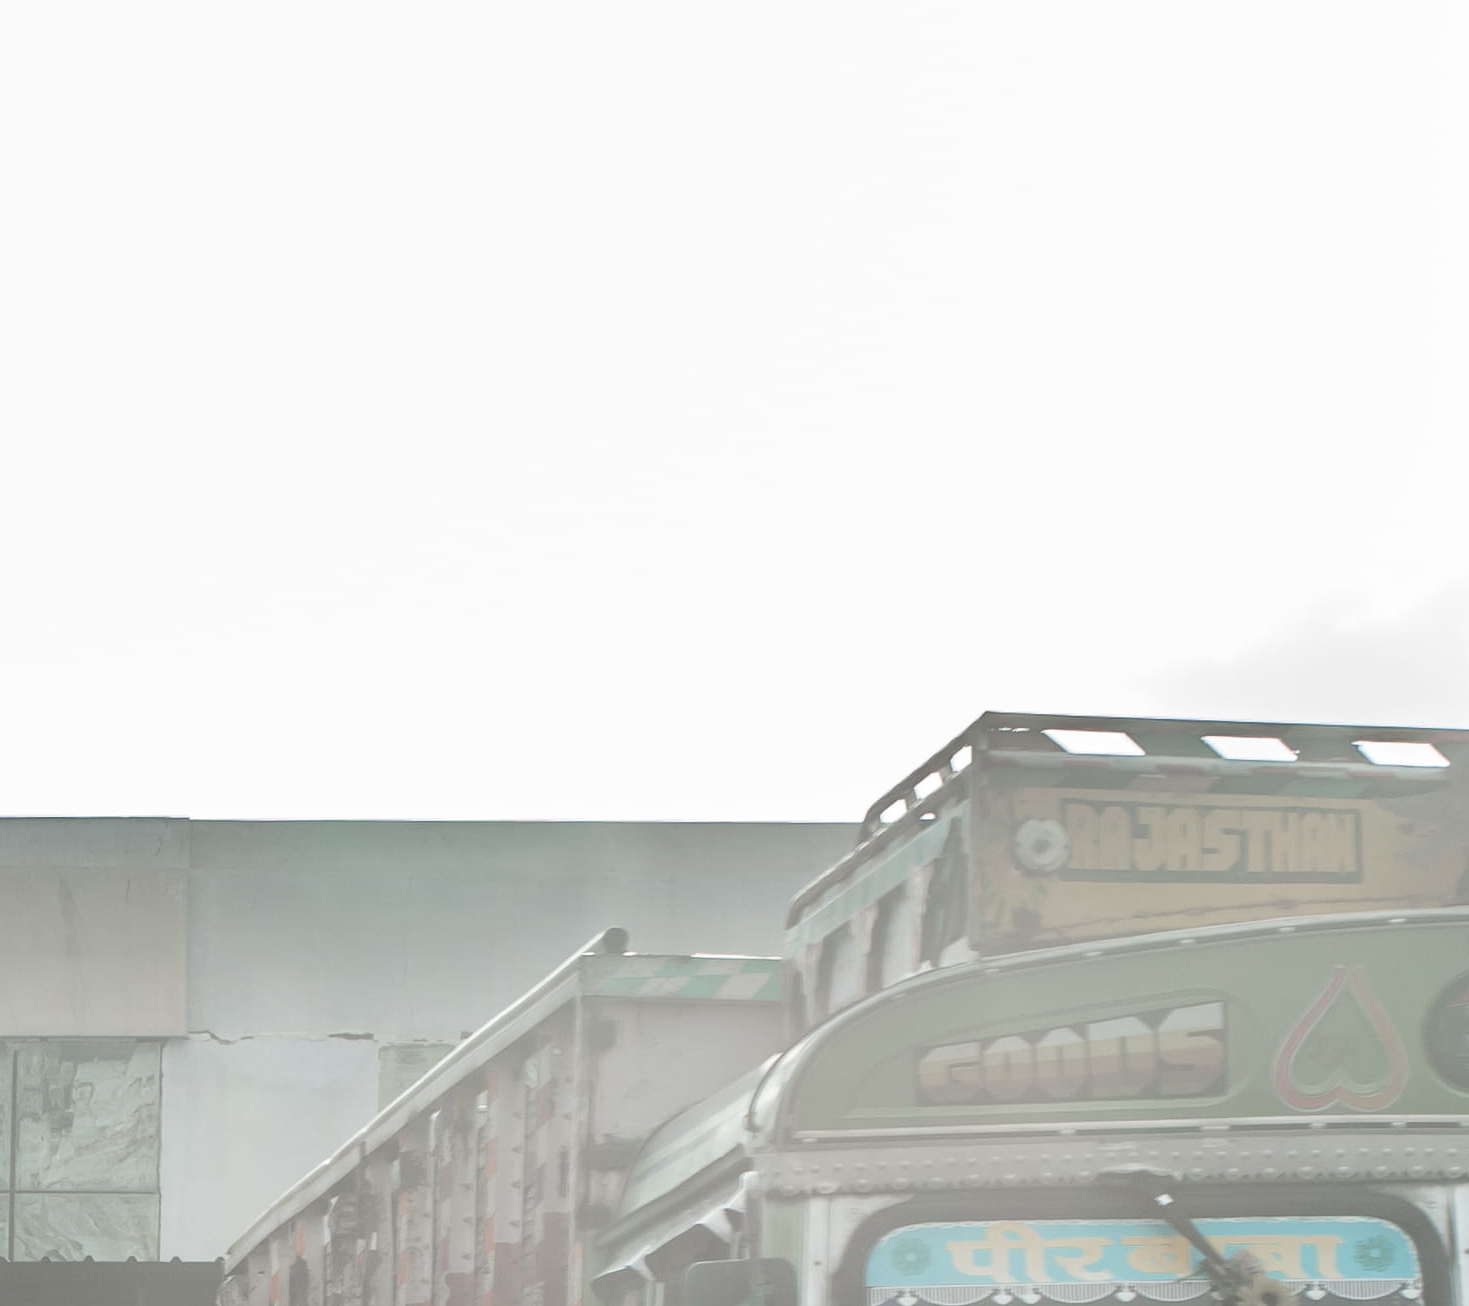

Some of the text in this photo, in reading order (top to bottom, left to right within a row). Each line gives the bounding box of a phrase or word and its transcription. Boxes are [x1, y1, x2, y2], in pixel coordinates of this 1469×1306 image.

[1065, 801, 1358, 874] RAJASTHAN
[917, 1001, 1224, 1106] GOODS
[946, 1221, 1115, 1283] पीर
